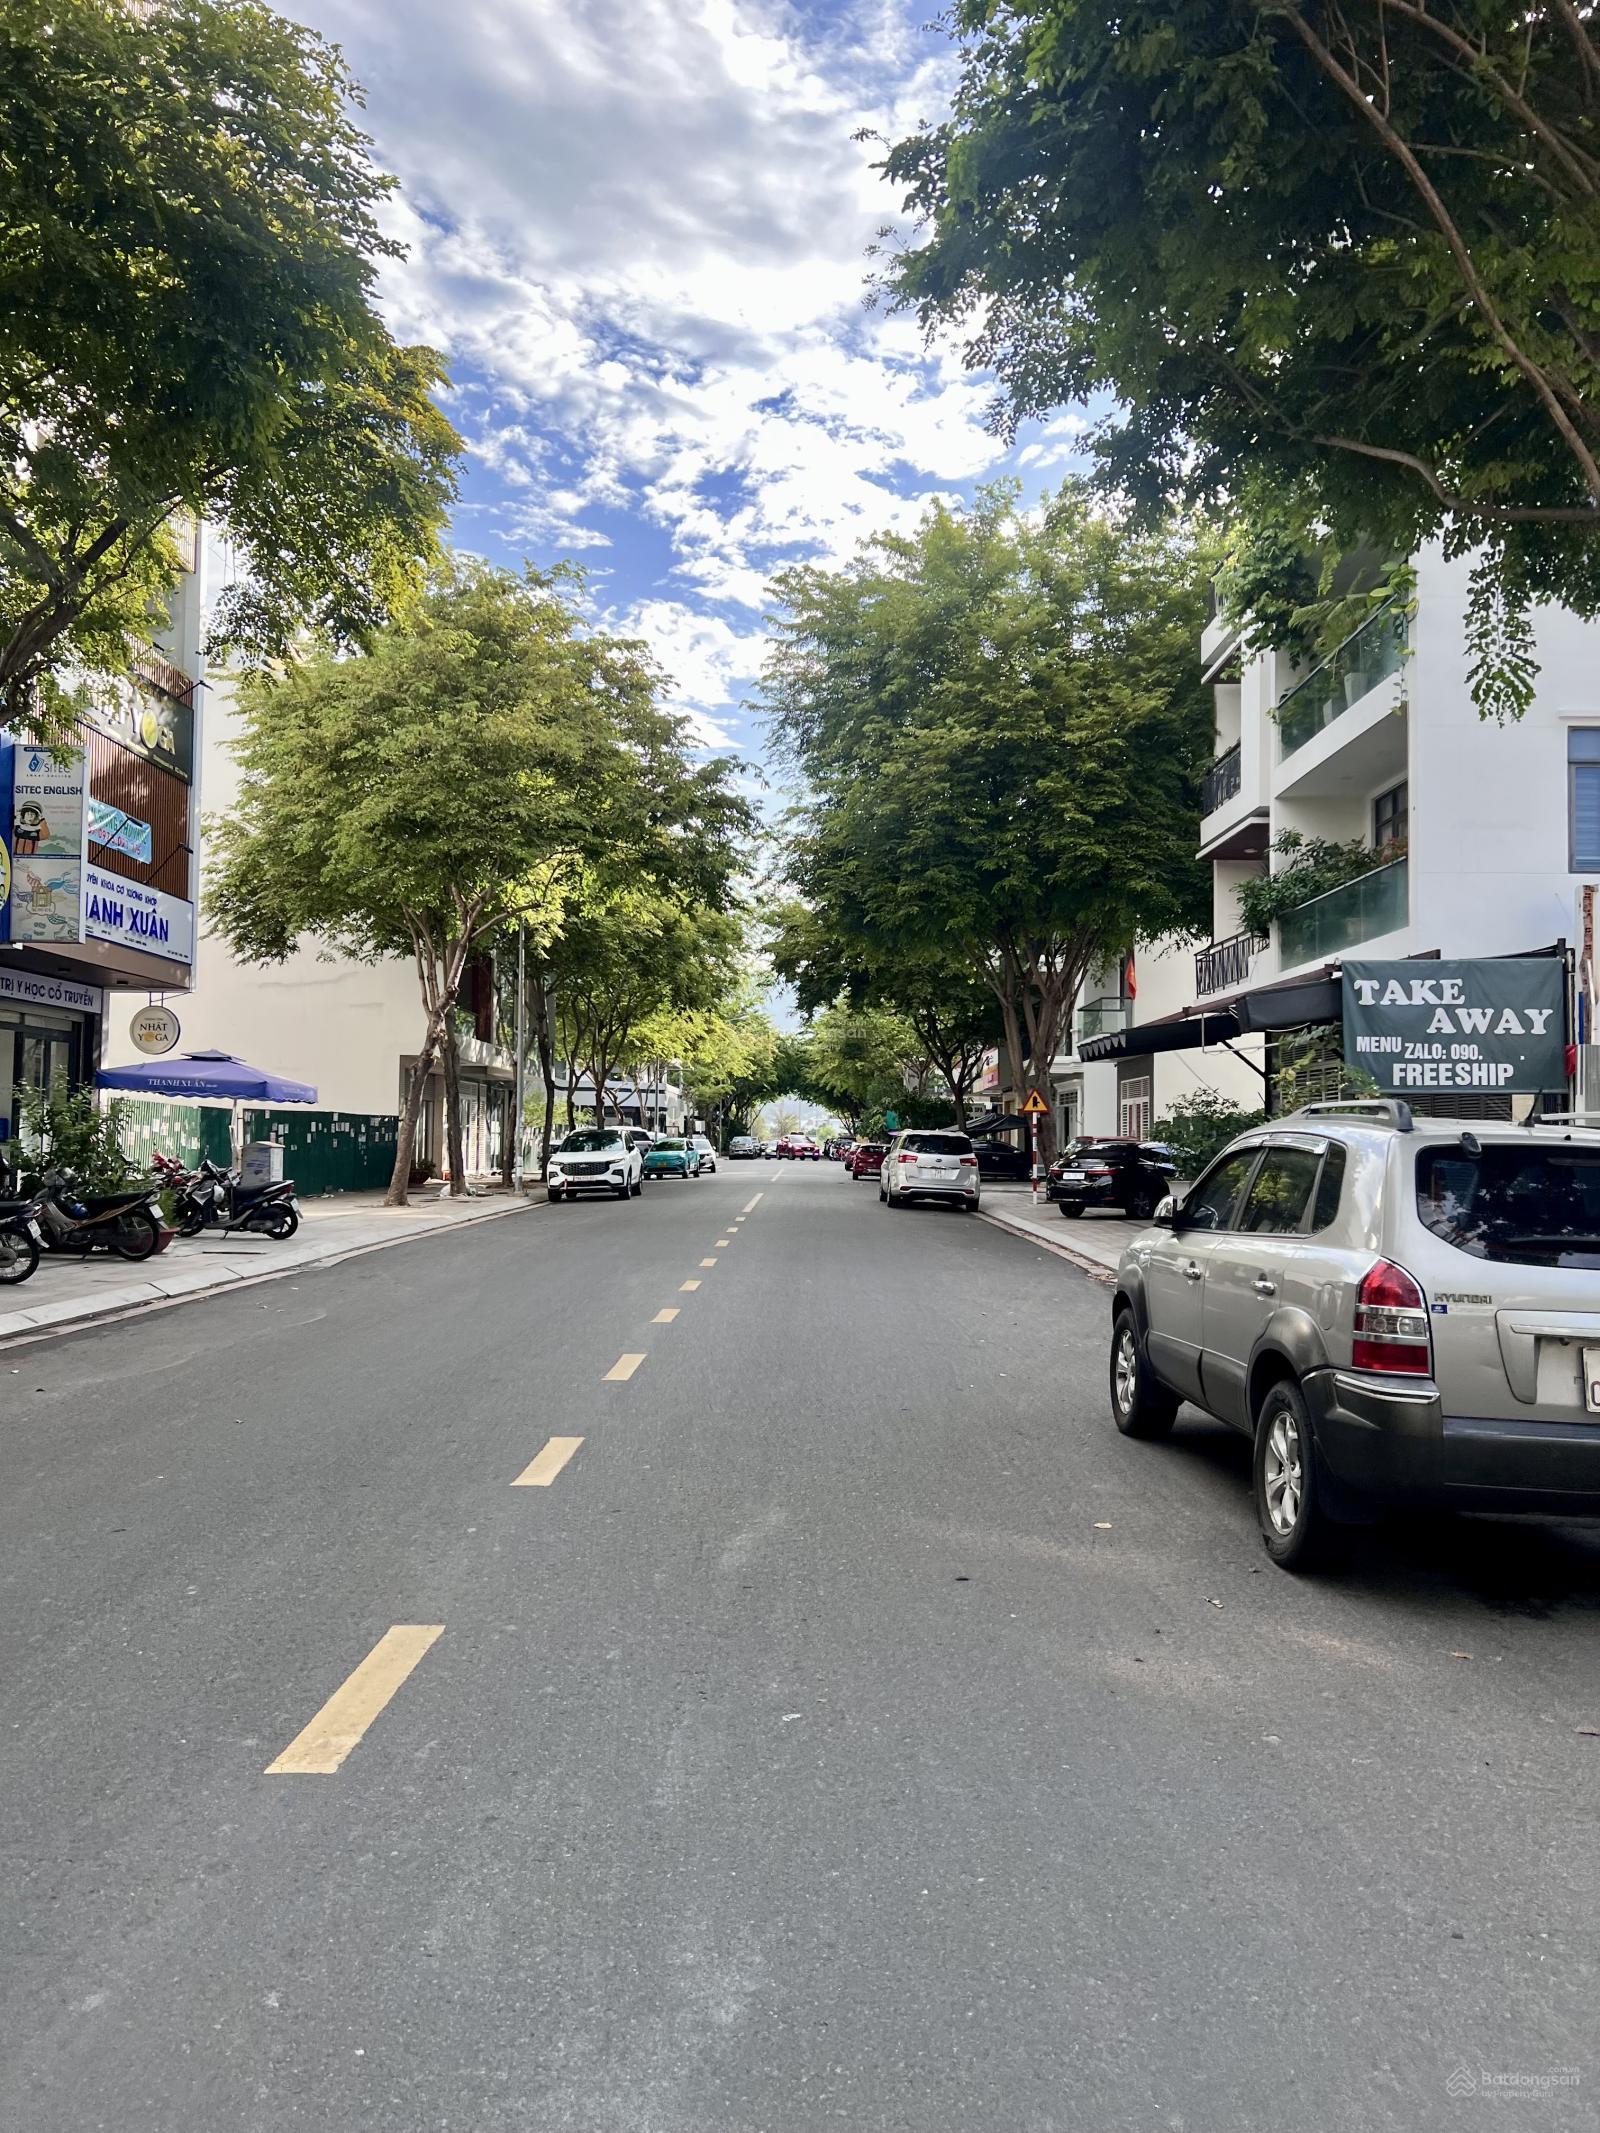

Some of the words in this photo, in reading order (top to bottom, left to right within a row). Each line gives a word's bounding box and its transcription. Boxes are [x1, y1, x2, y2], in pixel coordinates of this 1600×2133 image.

[15, 785, 42, 795] SITEC
[43, 785, 83, 795] ENGLISH
[100, 878, 115, 892] KHOA
[129, 907, 169, 942] XUÂN
[0, 976, 14, 995] TRỊ
[17, 980, 23, 992] Y
[24, 982, 46, 999] HỌC
[1353, 978, 1466, 1006] TAKE
[1425, 1007, 1554, 1035] AWAY
[1356, 1036, 1402, 1053] MENU
[1404, 1042, 1447, 1060] ZALO:
[1433, 1292, 1493, 1305] HYUNDAI
